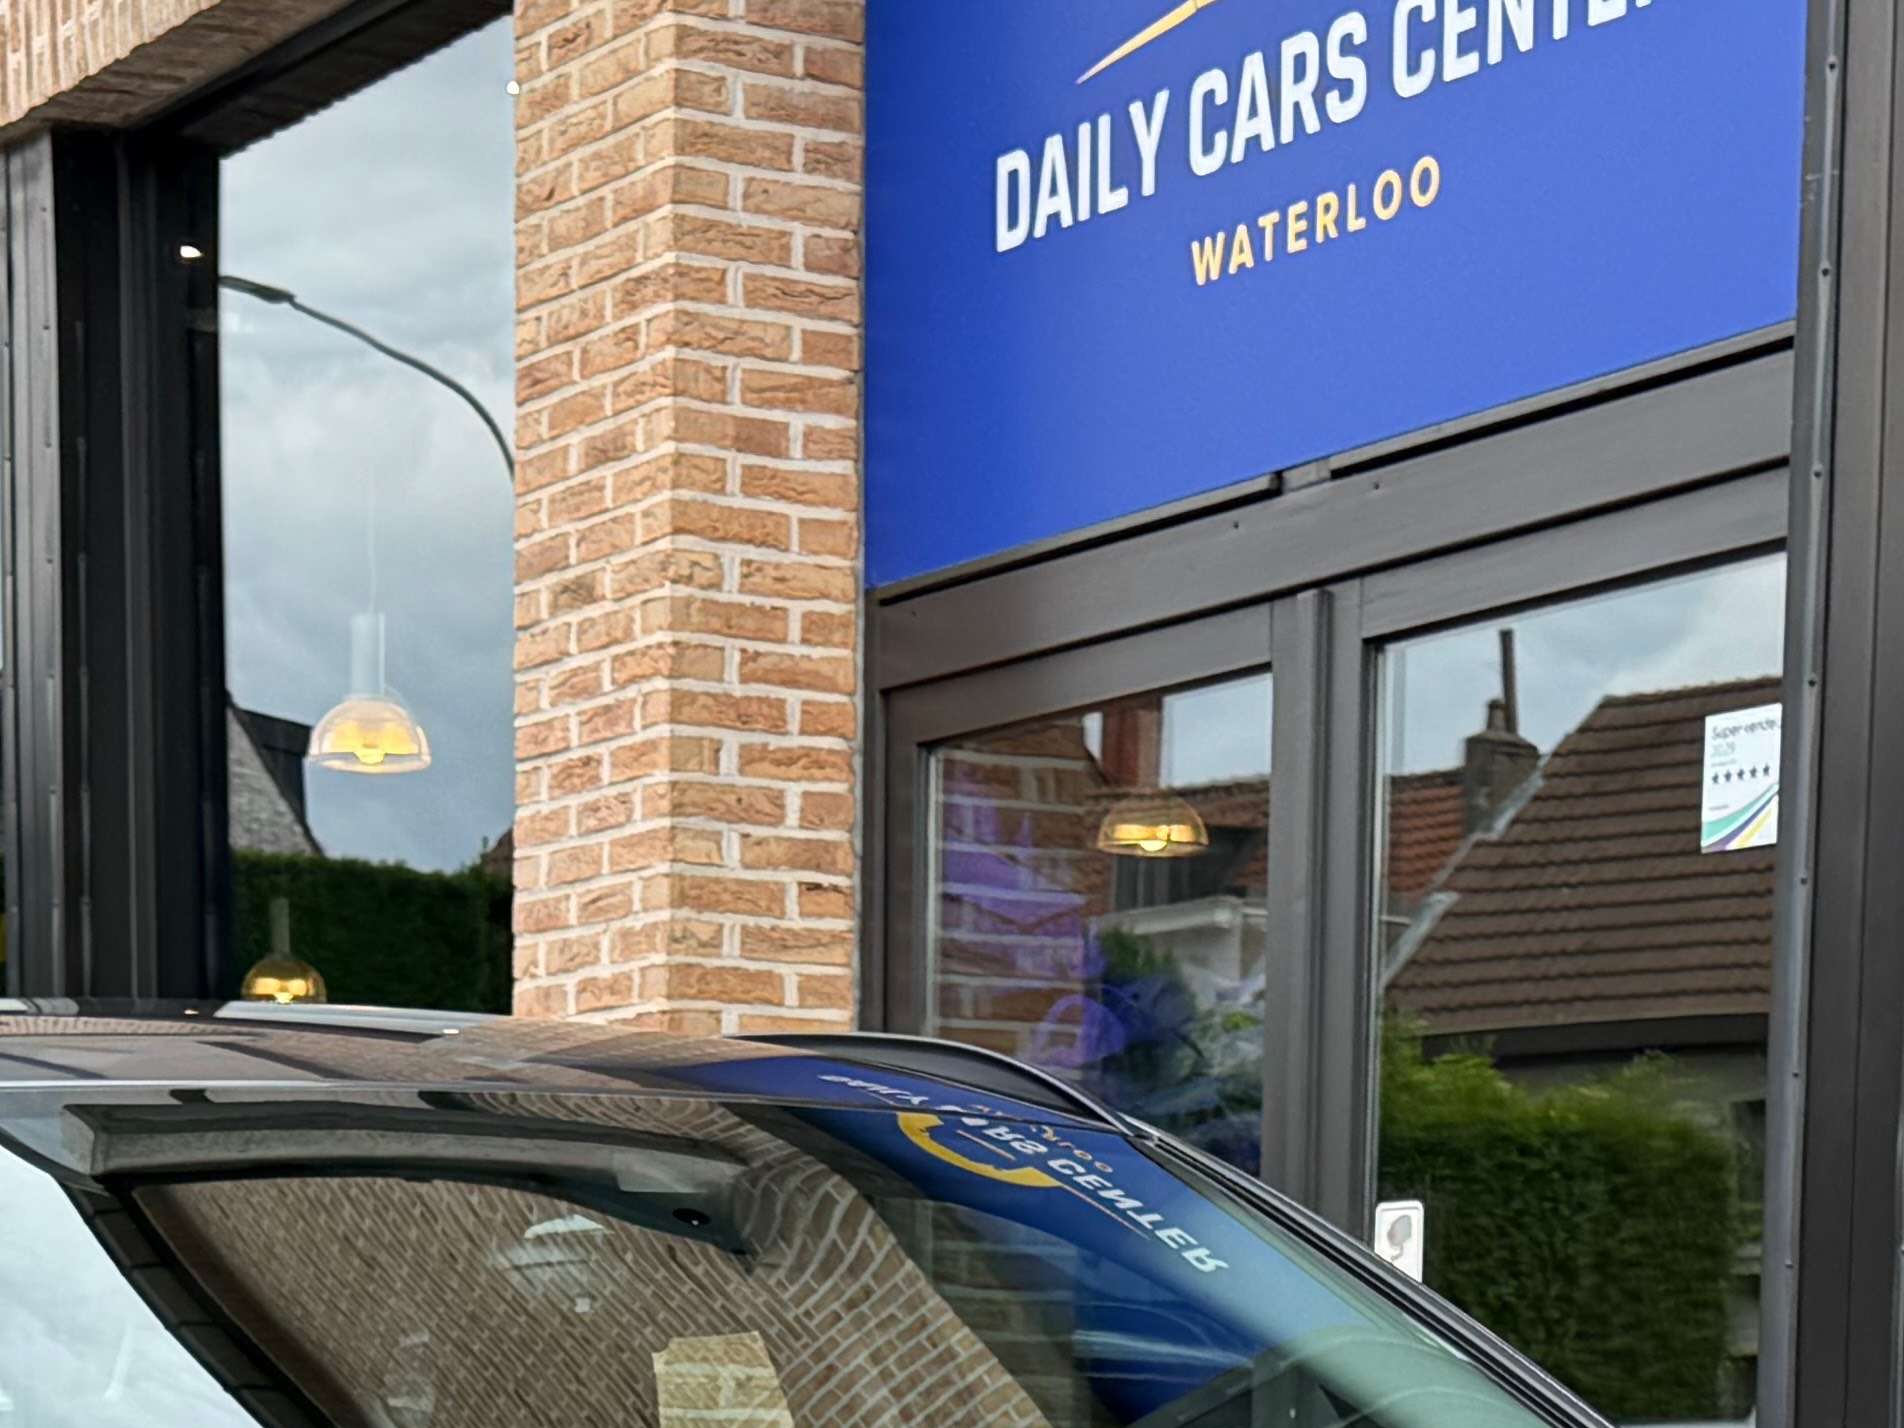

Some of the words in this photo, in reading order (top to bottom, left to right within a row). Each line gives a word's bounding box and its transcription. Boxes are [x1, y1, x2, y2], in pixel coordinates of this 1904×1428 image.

[995, 89, 1170, 253] DAILY
[1188, 10, 1367, 176] CARS
[1191, 155, 1440, 286] WATERLOO
